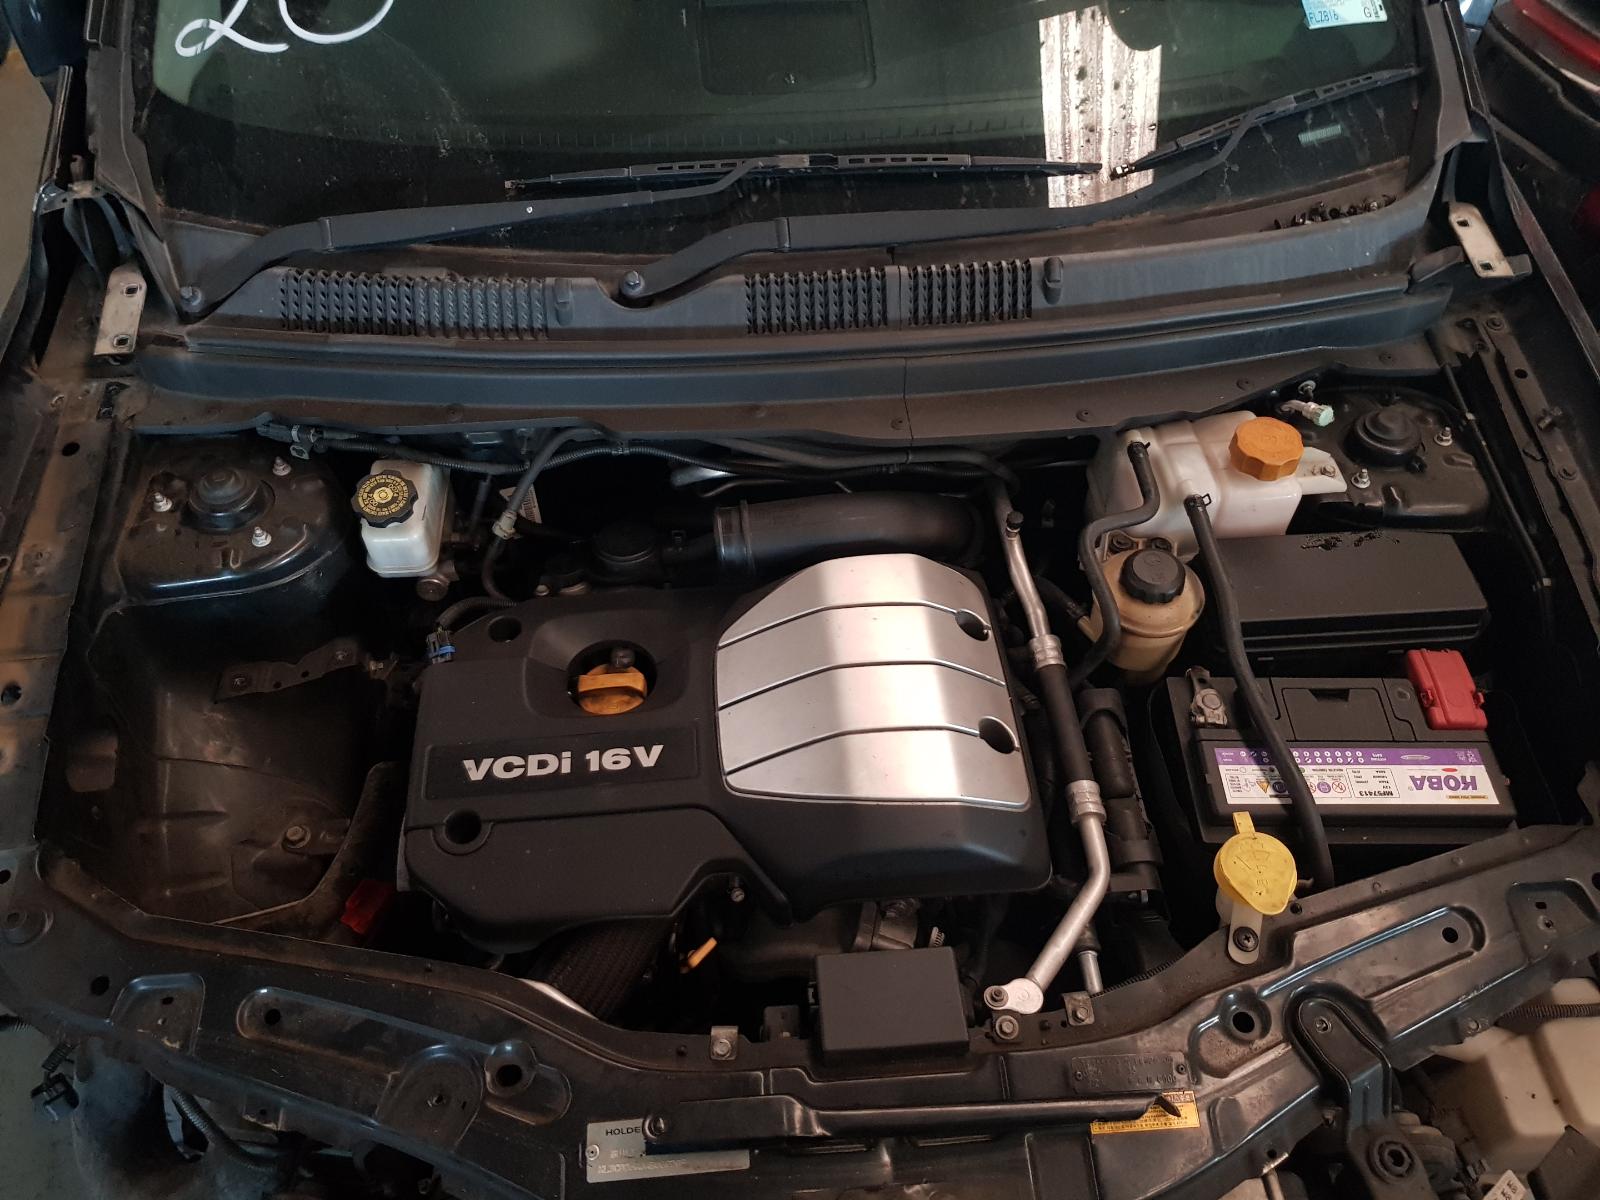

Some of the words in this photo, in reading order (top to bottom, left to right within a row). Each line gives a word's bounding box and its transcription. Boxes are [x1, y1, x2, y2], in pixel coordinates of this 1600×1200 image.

[463, 751, 572, 781] VCDi
[585, 744, 664, 772] 16V
[1409, 774, 1478, 792] KOBA
[605, 1126, 641, 1137] HOLDE
